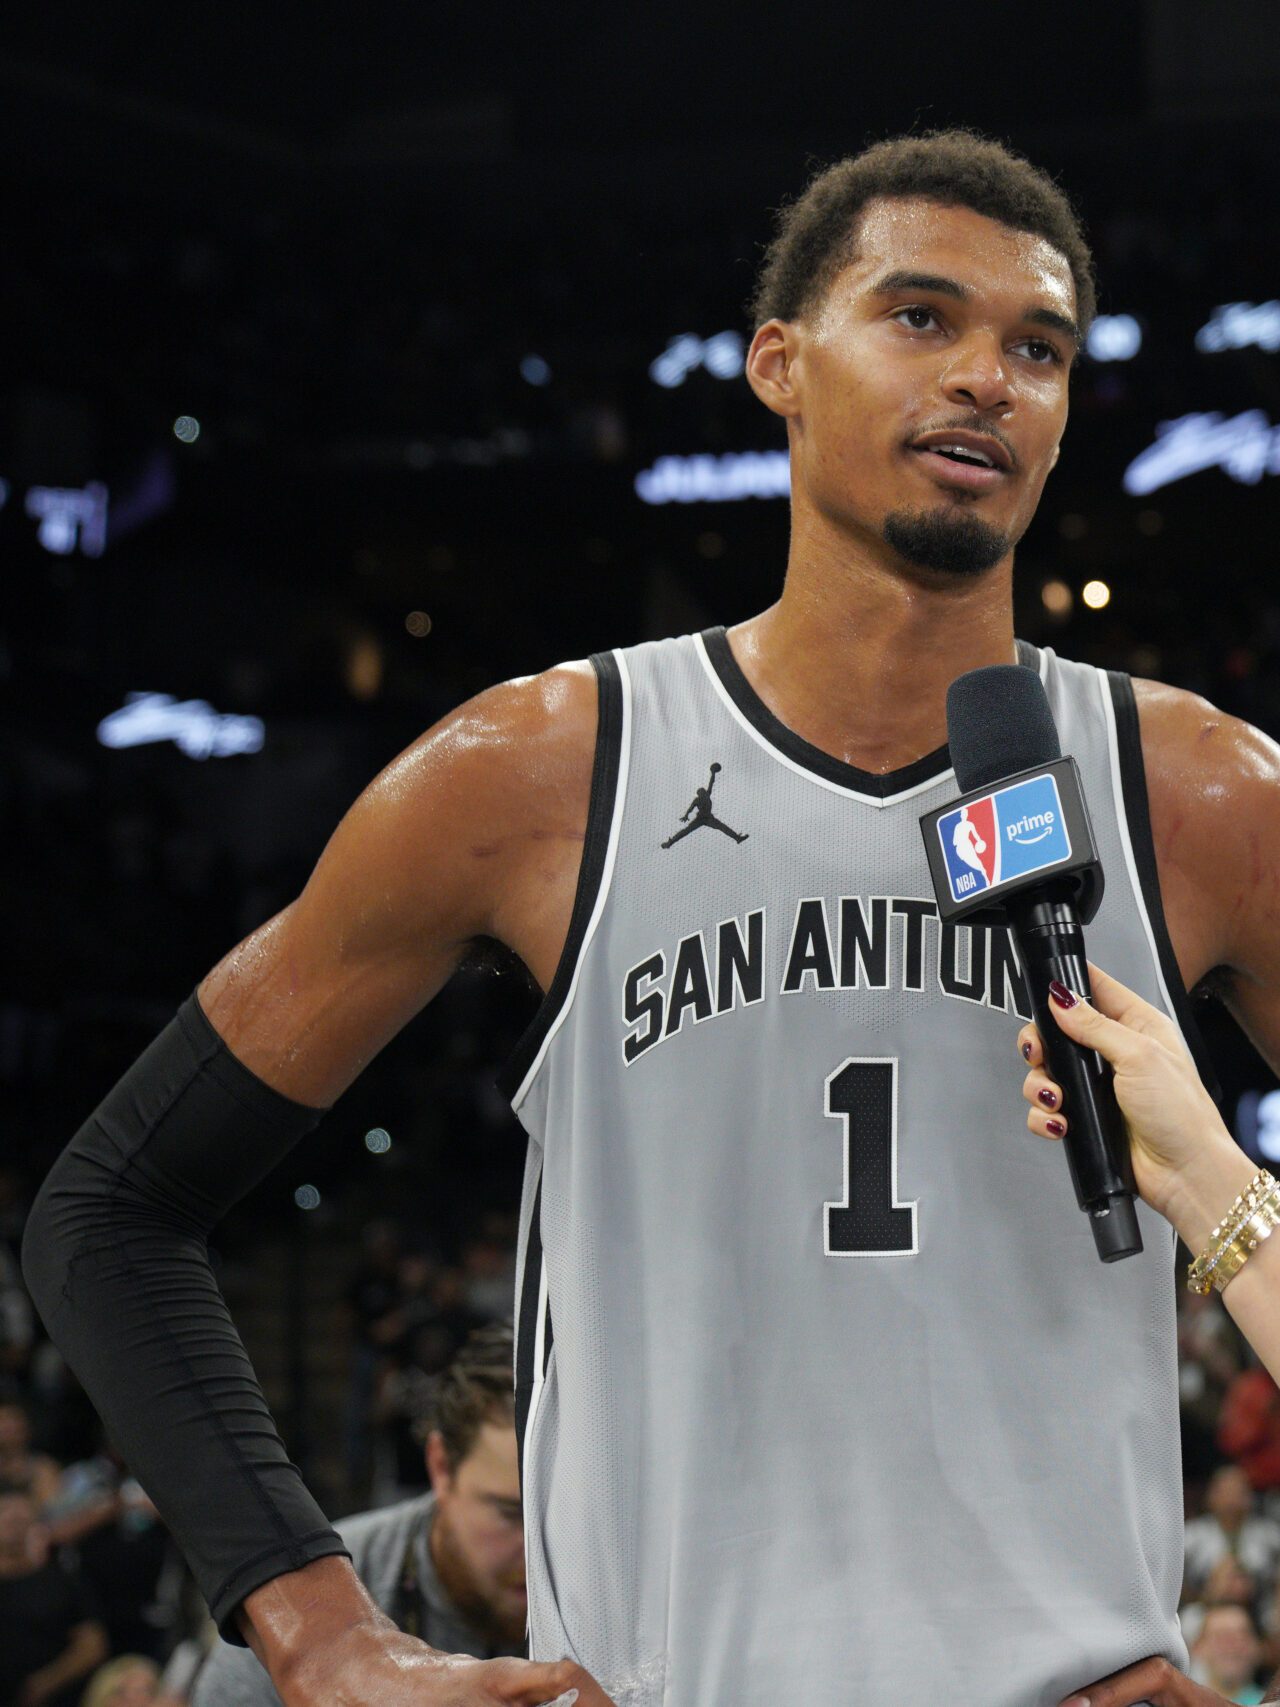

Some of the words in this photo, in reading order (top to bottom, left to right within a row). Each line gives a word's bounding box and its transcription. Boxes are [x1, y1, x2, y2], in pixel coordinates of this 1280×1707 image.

[1006, 811, 1055, 841] prime
[956, 872, 977, 894] NBA
[622, 907, 766, 1067] SAN
[824, 1057, 919, 1256] 1
